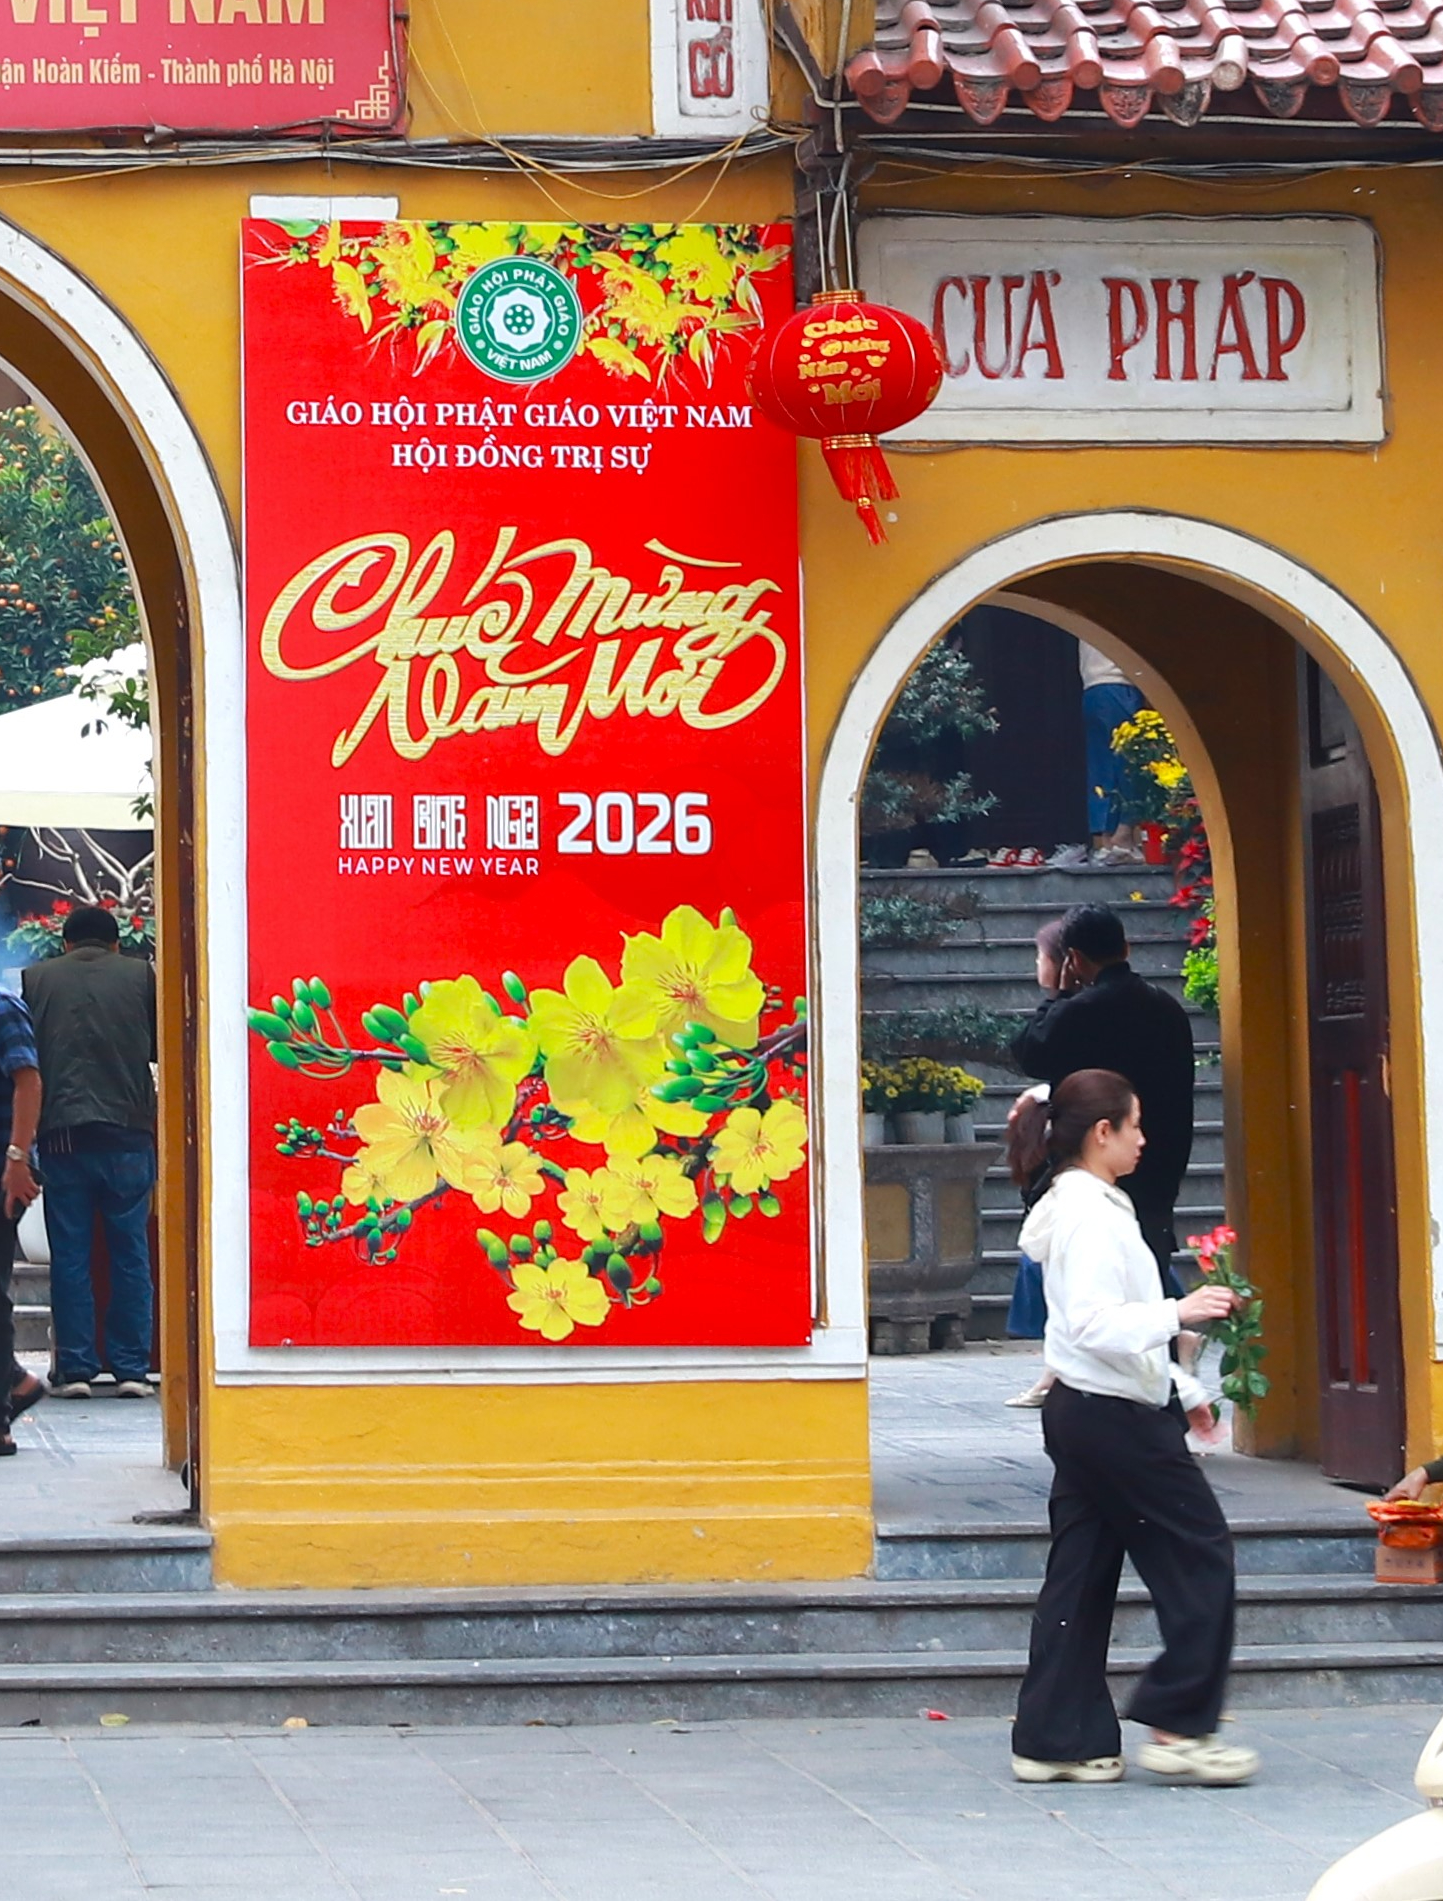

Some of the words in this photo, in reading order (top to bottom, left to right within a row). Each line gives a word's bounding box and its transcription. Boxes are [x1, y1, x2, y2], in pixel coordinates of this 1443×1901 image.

[32, 56, 84, 84] Hoàn
[89, 52, 141, 84] Kiếm
[161, 57, 221, 84] Thành
[226, 53, 263, 87] phố
[269, 57, 295, 84] Hà
[301, 58, 334, 91] Nội
[465, 293, 485, 336] GIÁO
[480, 270, 510, 294] HỘI
[512, 268, 557, 293] PHẬT
[553, 294, 574, 336] GIÁO
[1102, 270, 1307, 383] PHÁP
[486, 347, 519, 371] VIỆT
[519, 349, 554, 371] NAM
[797, 359, 849, 380] Năm
[286, 399, 363, 427] GIÁO
[371, 397, 427, 432] HỘI
[435, 397, 517, 432] PHẬT
[524, 398, 600, 428] GIÁO
[606, 399, 678, 433] VIỆT
[685, 405, 753, 428] NAM
[392, 437, 448, 473] HỘI
[455, 432, 544, 468] ĐỒNG
[550, 445, 603, 474] TRỊ
[611, 443, 652, 475] SỰ
[259, 525, 534, 682] Chúc
[502, 535, 784, 658] Mừng
[557, 792, 713, 855] 2026
[338, 857, 415, 875] HAPPY
[422, 857, 474, 875] NEW
[480, 857, 540, 876] YEAR
